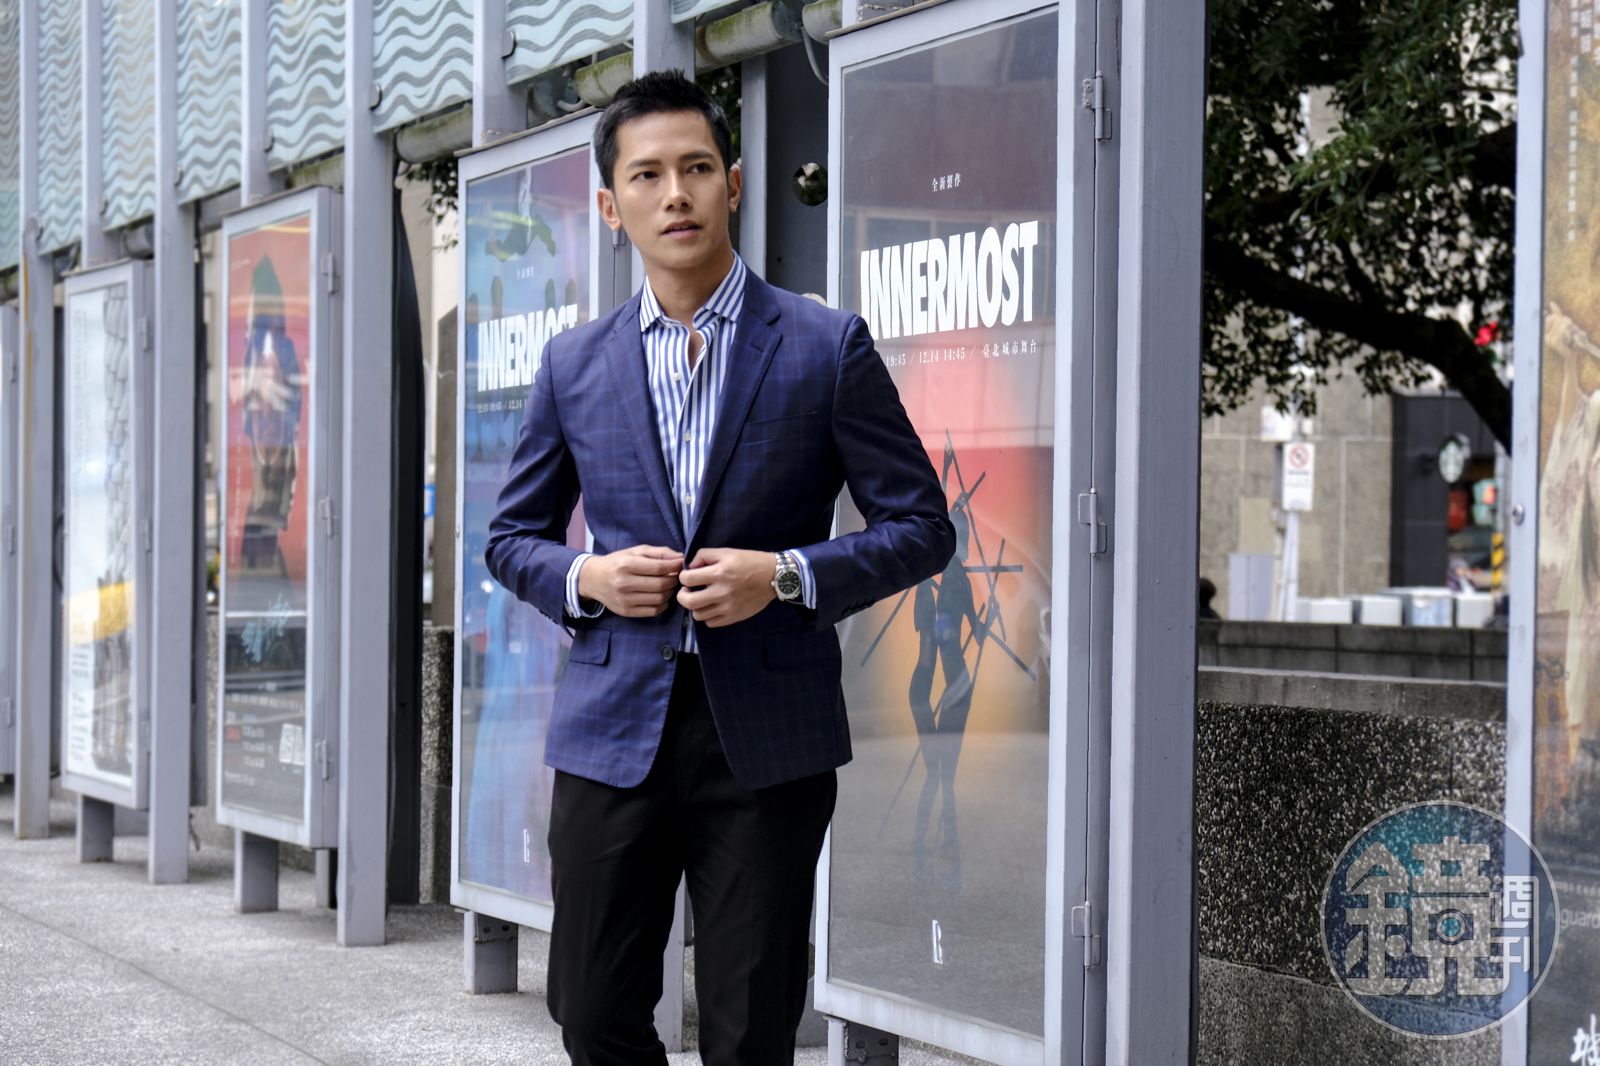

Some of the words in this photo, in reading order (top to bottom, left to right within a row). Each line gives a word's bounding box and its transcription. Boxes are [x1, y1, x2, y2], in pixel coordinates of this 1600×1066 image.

[860, 220, 1039, 341] INNERMOST
[477, 303, 578, 392] INNERM
[919, 349, 939, 364] 12.14
[943, 347, 965, 361] 14:45
